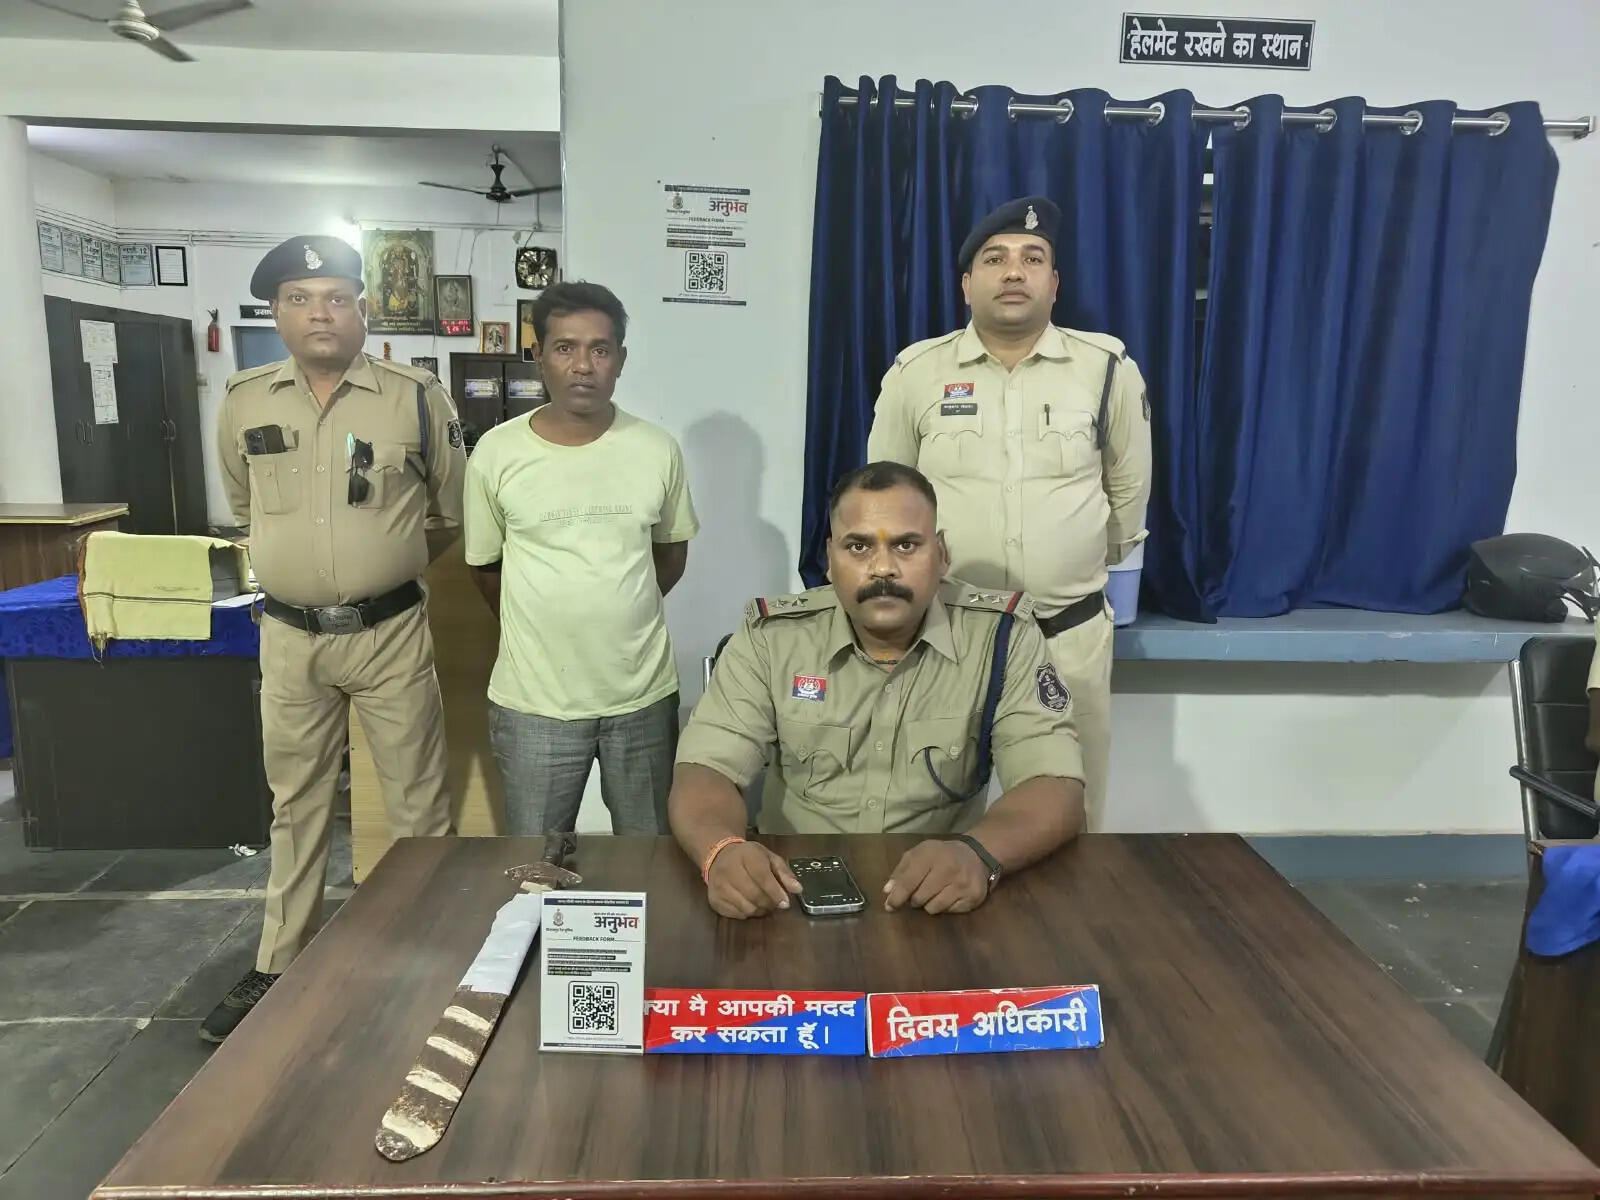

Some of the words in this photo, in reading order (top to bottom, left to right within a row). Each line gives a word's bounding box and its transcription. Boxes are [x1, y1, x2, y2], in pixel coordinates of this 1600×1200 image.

[1130, 17, 1178, 59] हेलमेट
[1184, 21, 1227, 58] रखने
[1233, 33, 1256, 58] का
[1262, 33, 1304, 59] स्थान
[709, 200, 748, 216] अनुभव
[594, 916, 639, 933] अनुभव
[717, 994, 795, 1017] आपकी
[804, 1000, 857, 1017] मदद
[887, 1006, 959, 1041] दिवस
[973, 997, 1087, 1036] अधिकारी
[670, 1026, 707, 1043] कर
[717, 1026, 788, 1043] सकता
